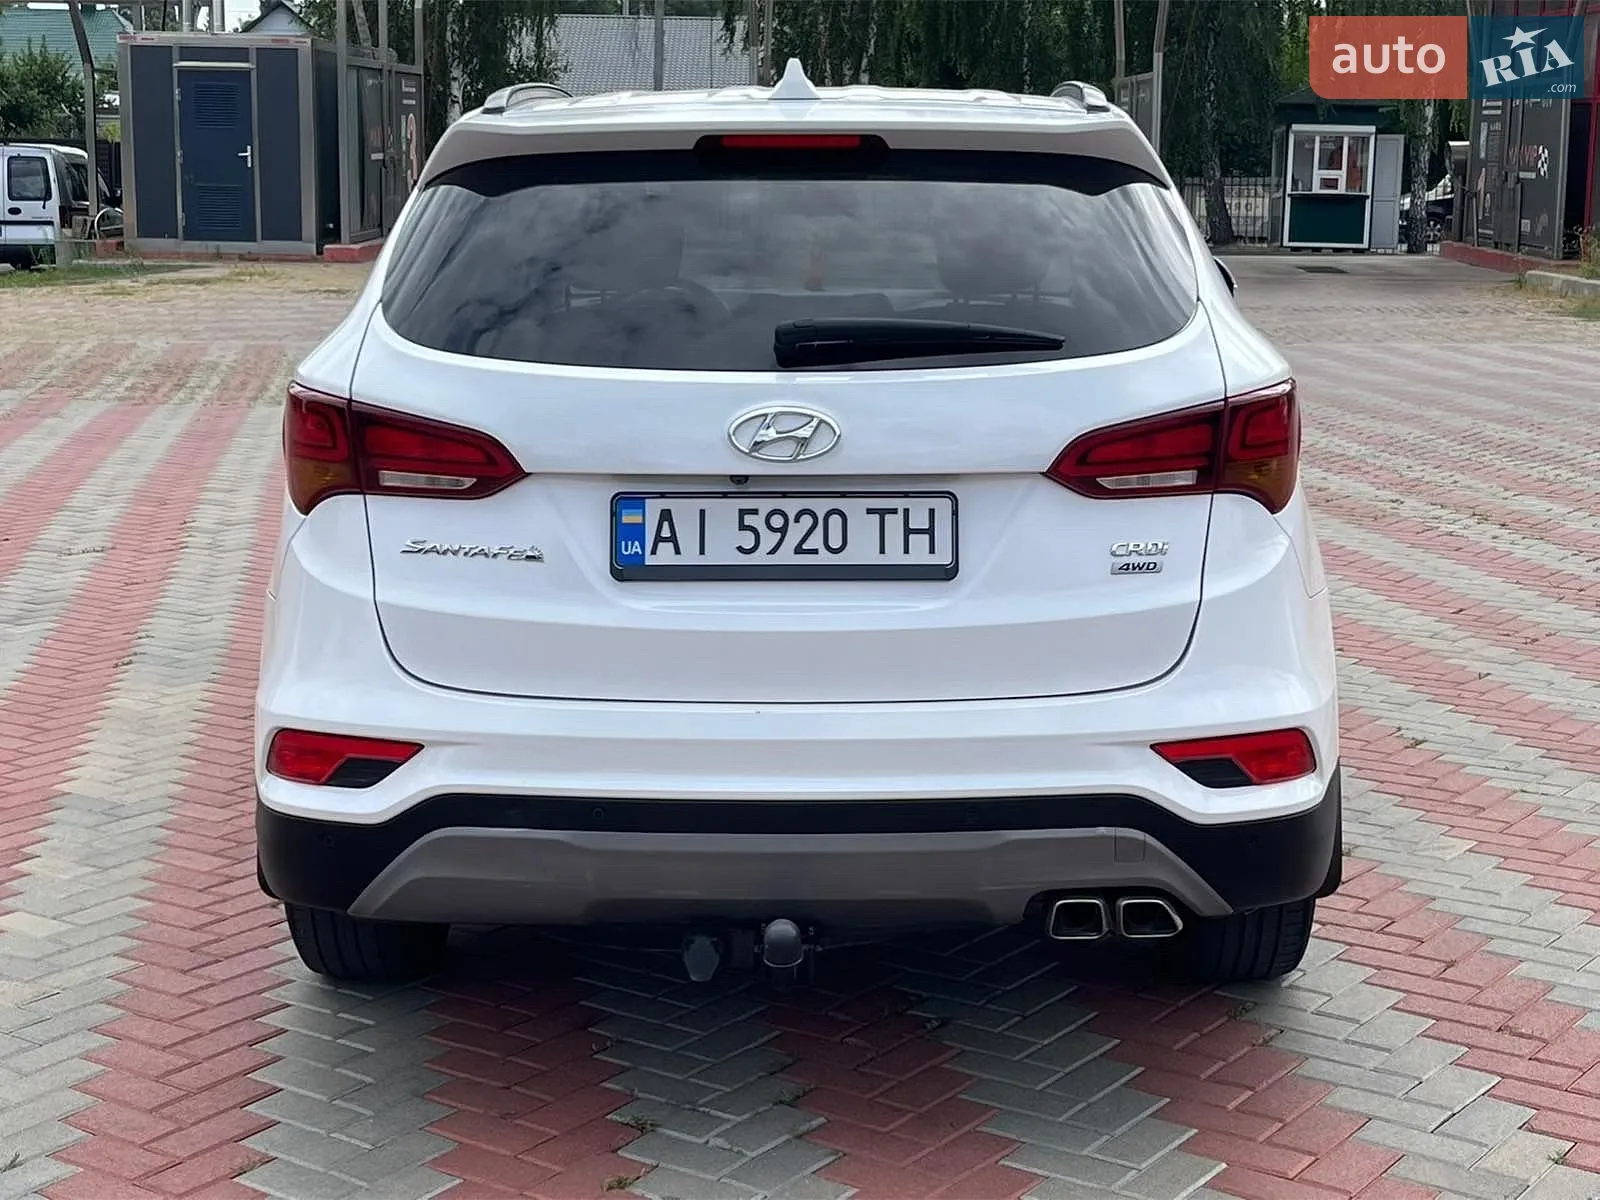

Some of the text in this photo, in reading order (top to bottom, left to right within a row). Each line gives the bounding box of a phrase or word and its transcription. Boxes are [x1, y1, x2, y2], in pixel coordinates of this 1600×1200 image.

[735, 508, 848, 556] 5920
[866, 507, 936, 555] TH
[621, 541, 642, 555] UA
[1118, 561, 1158, 571] 4WD
